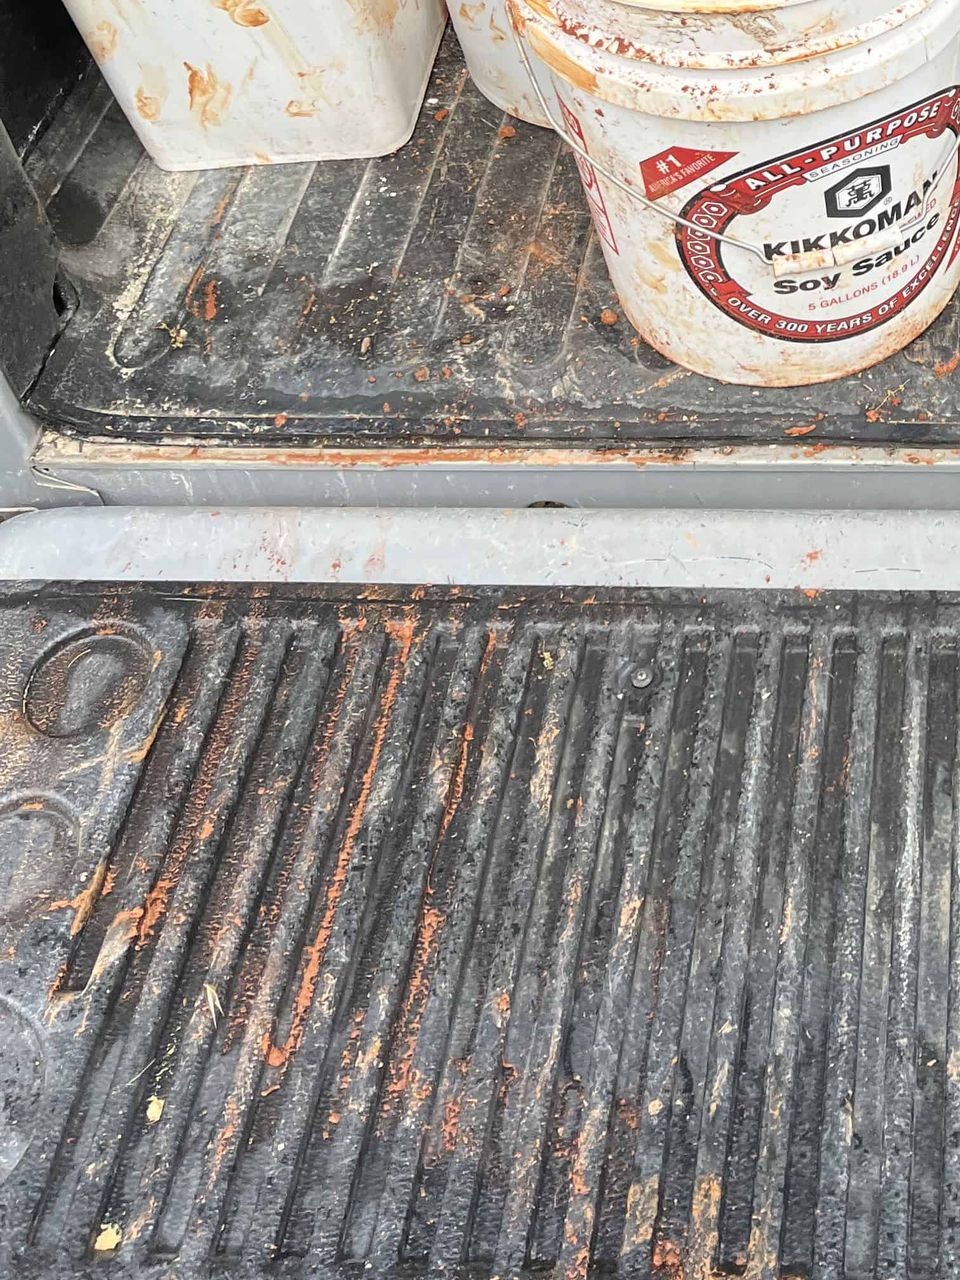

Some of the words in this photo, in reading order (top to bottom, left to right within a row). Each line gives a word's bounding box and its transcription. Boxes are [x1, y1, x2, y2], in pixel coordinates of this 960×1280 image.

[655, 154, 682, 174] #1
[681, 153, 716, 177] FAVORITE
[810, 138, 899, 178] SEASONING
[727, 297, 772, 325] OVER
[775, 320, 808, 333] 300
[815, 313, 873, 334] YEARS
[878, 298, 898, 315] OF
[902, 198, 960, 299] EXCELLENCE
[773, 272, 841, 295] Soy
[852, 212, 940, 277] Sauce
[808, 302, 817, 311] 5
[820, 281, 879, 309] GALLONS
